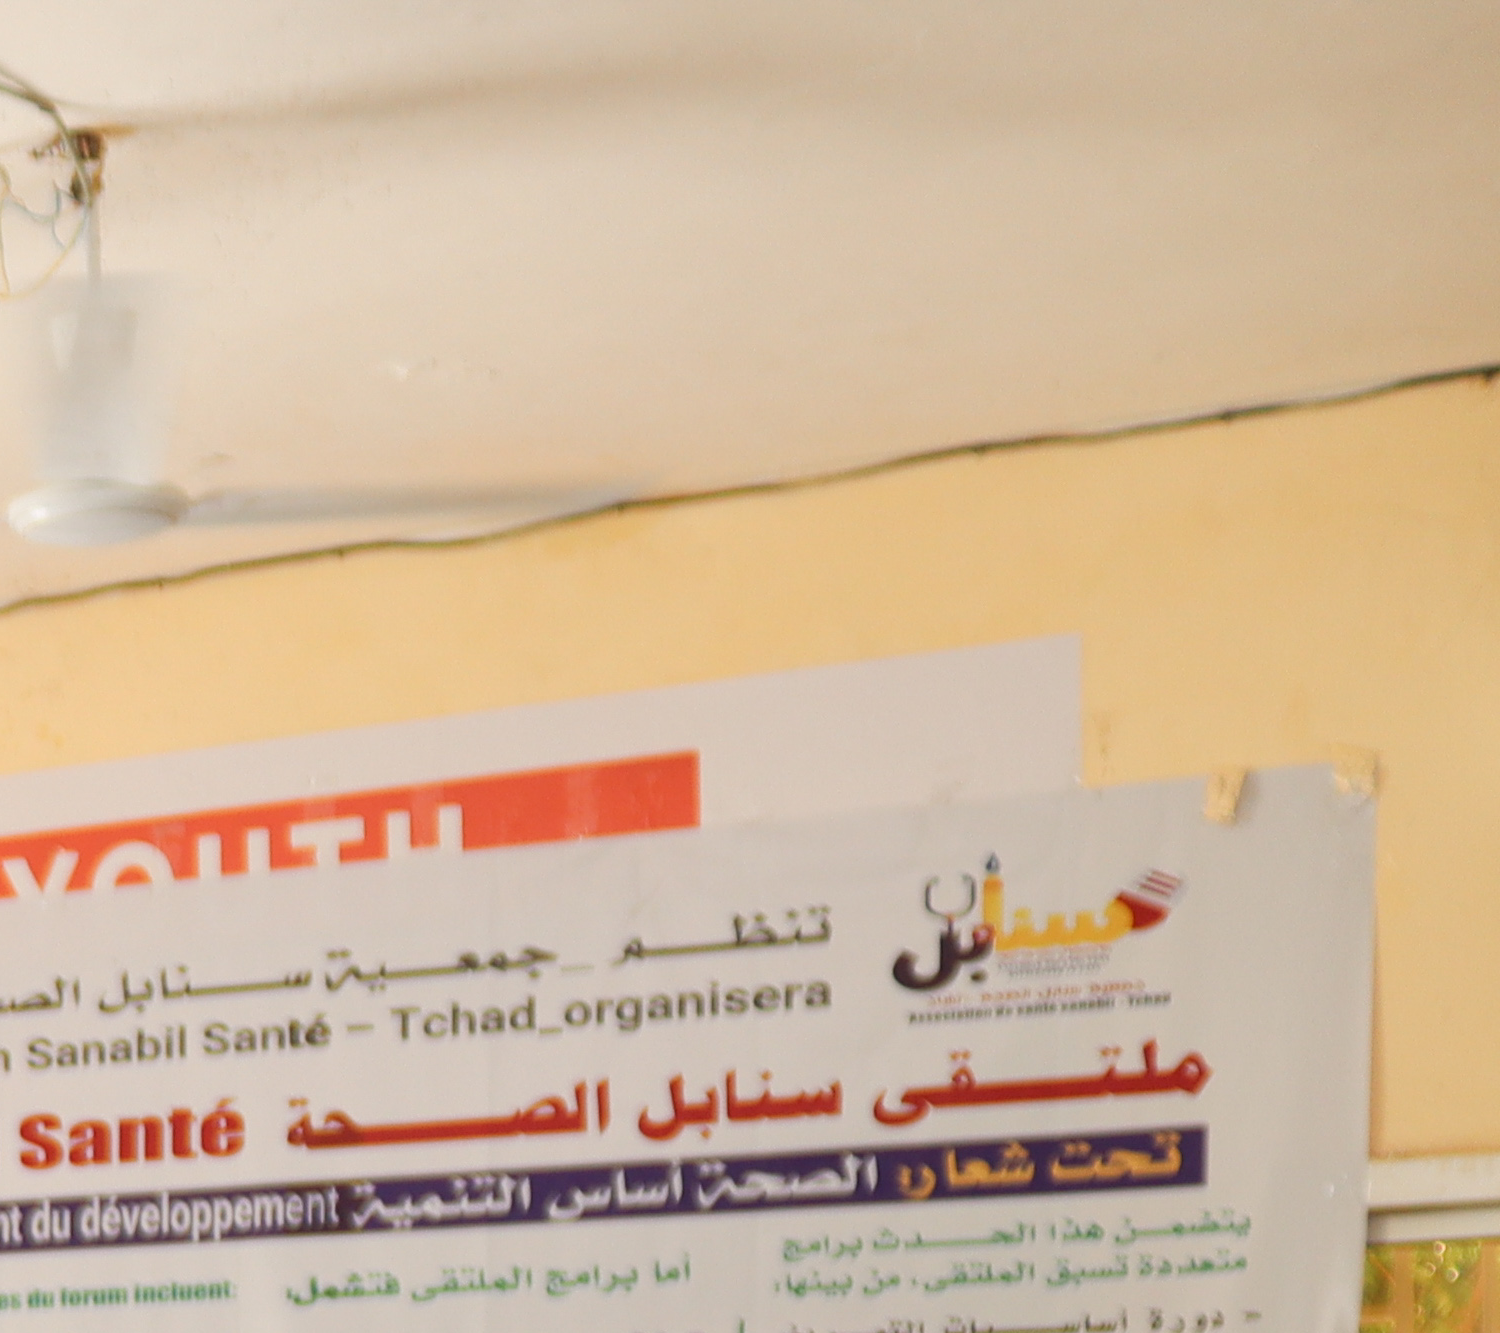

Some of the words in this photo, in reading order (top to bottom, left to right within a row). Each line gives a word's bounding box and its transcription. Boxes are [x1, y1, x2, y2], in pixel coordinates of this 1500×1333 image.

[98, 964, 312, 1014] سنابل
[26, 1024, 187, 1071] Sanabil
[202, 1012, 332, 1055] Santé
[638, 1068, 844, 1140] سنابل
[873, 1036, 1215, 1126] ملتقى
[18, 1097, 247, 1171] Santé
[287, 1076, 611, 1150] الصحة
[699, 1151, 880, 1211] الصحة
[1051, 1130, 1183, 1182] تحت
[30, 1201, 72, 1241] du
[80, 1187, 340, 1242] développement
[352, 1172, 532, 1231] التنمية
[26, 1288, 55, 1310] du
[60, 1285, 129, 1308] forum
[411, 1265, 534, 1304] الملتقى
